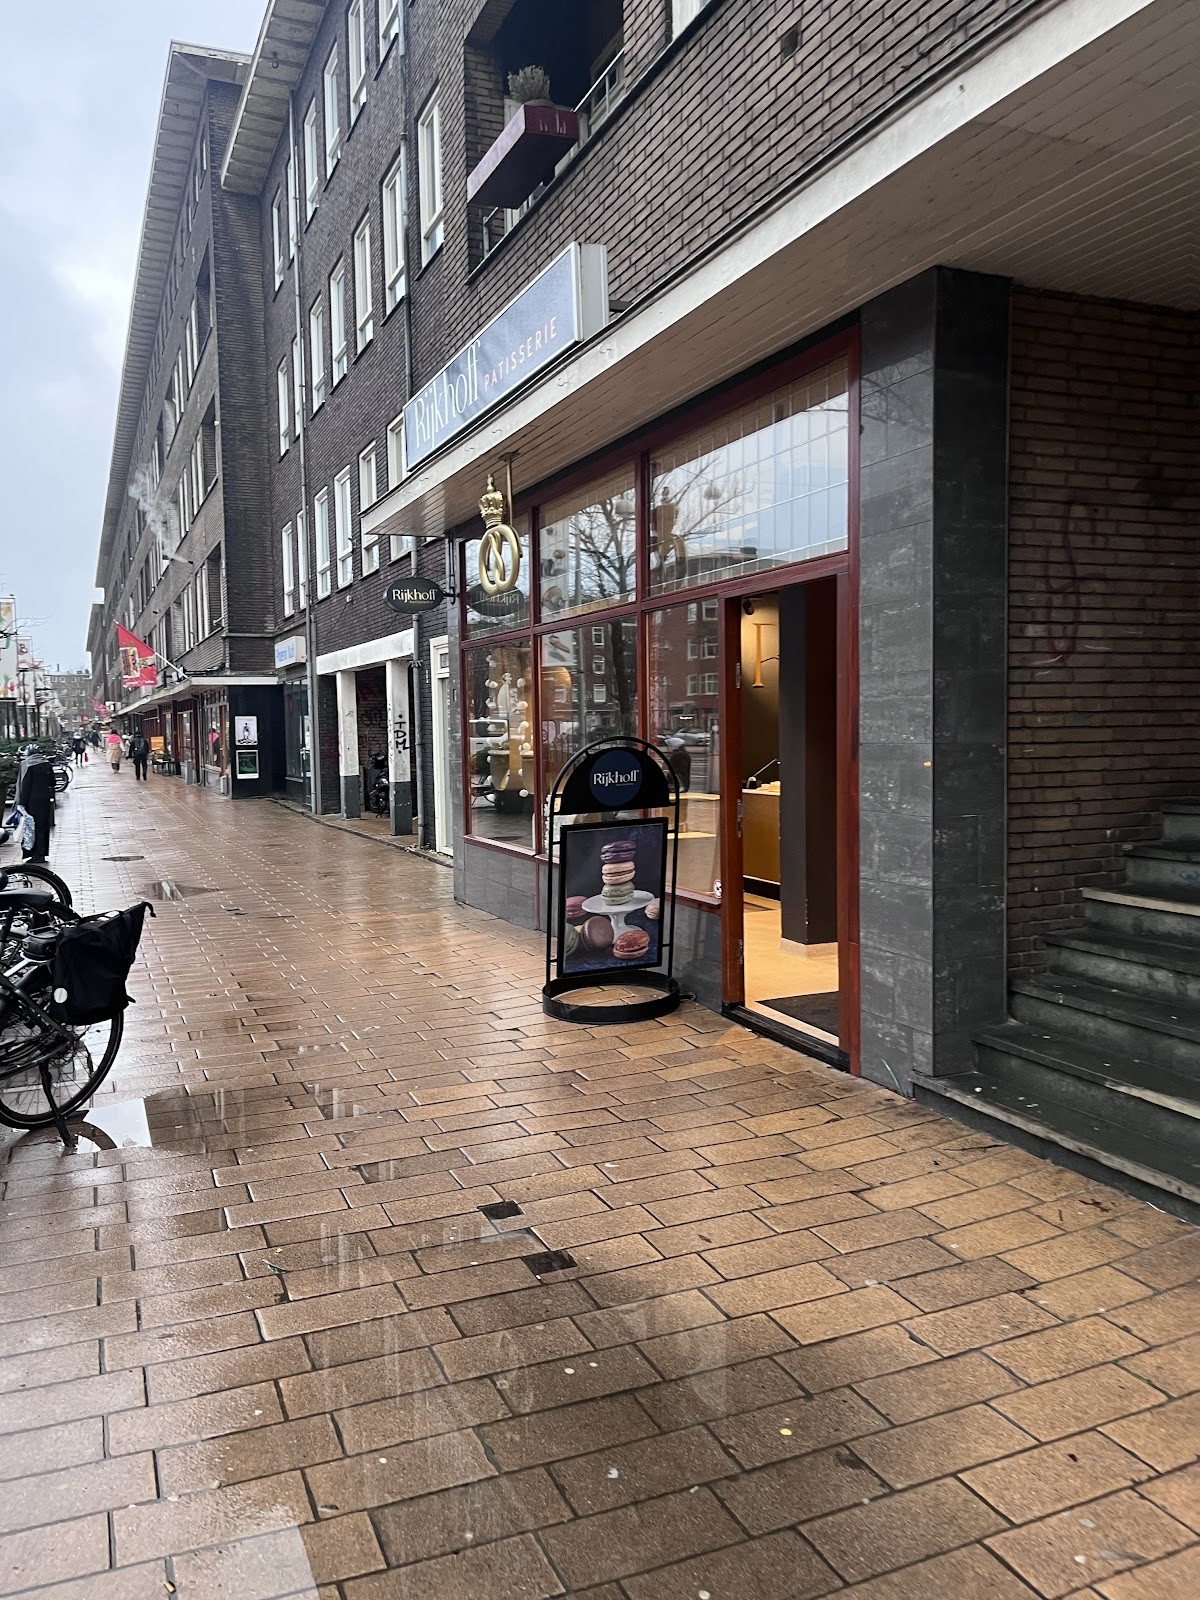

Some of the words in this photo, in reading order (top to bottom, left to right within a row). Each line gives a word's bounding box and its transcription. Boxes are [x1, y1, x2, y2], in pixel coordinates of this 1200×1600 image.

[414, 339, 481, 449] Rijkhoff
[484, 316, 557, 392] PATISSERIE
[392, 588, 438, 603] Rijkhoff
[593, 769, 640, 787] Rijkhoff
